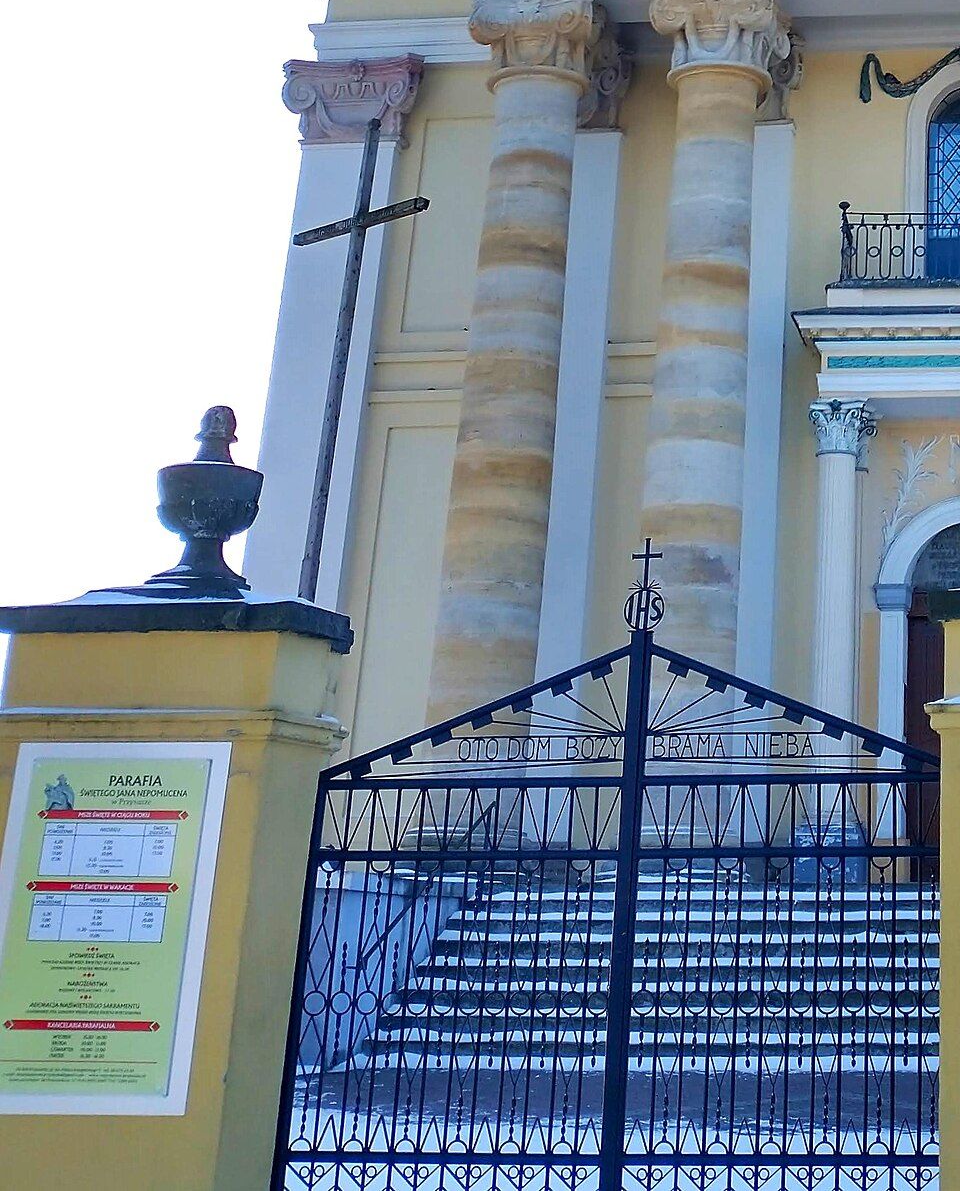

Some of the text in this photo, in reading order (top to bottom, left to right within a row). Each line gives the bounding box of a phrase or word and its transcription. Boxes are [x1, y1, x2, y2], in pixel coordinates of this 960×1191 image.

[458, 738, 499, 760] OTO
[507, 737, 550, 759] DOM
[652, 733, 814, 757] BRAMA NIEBA
[108, 775, 162, 786] PARAFIA
[116, 790, 135, 798] JANA
[136, 790, 187, 798] NEPOMUCENA
